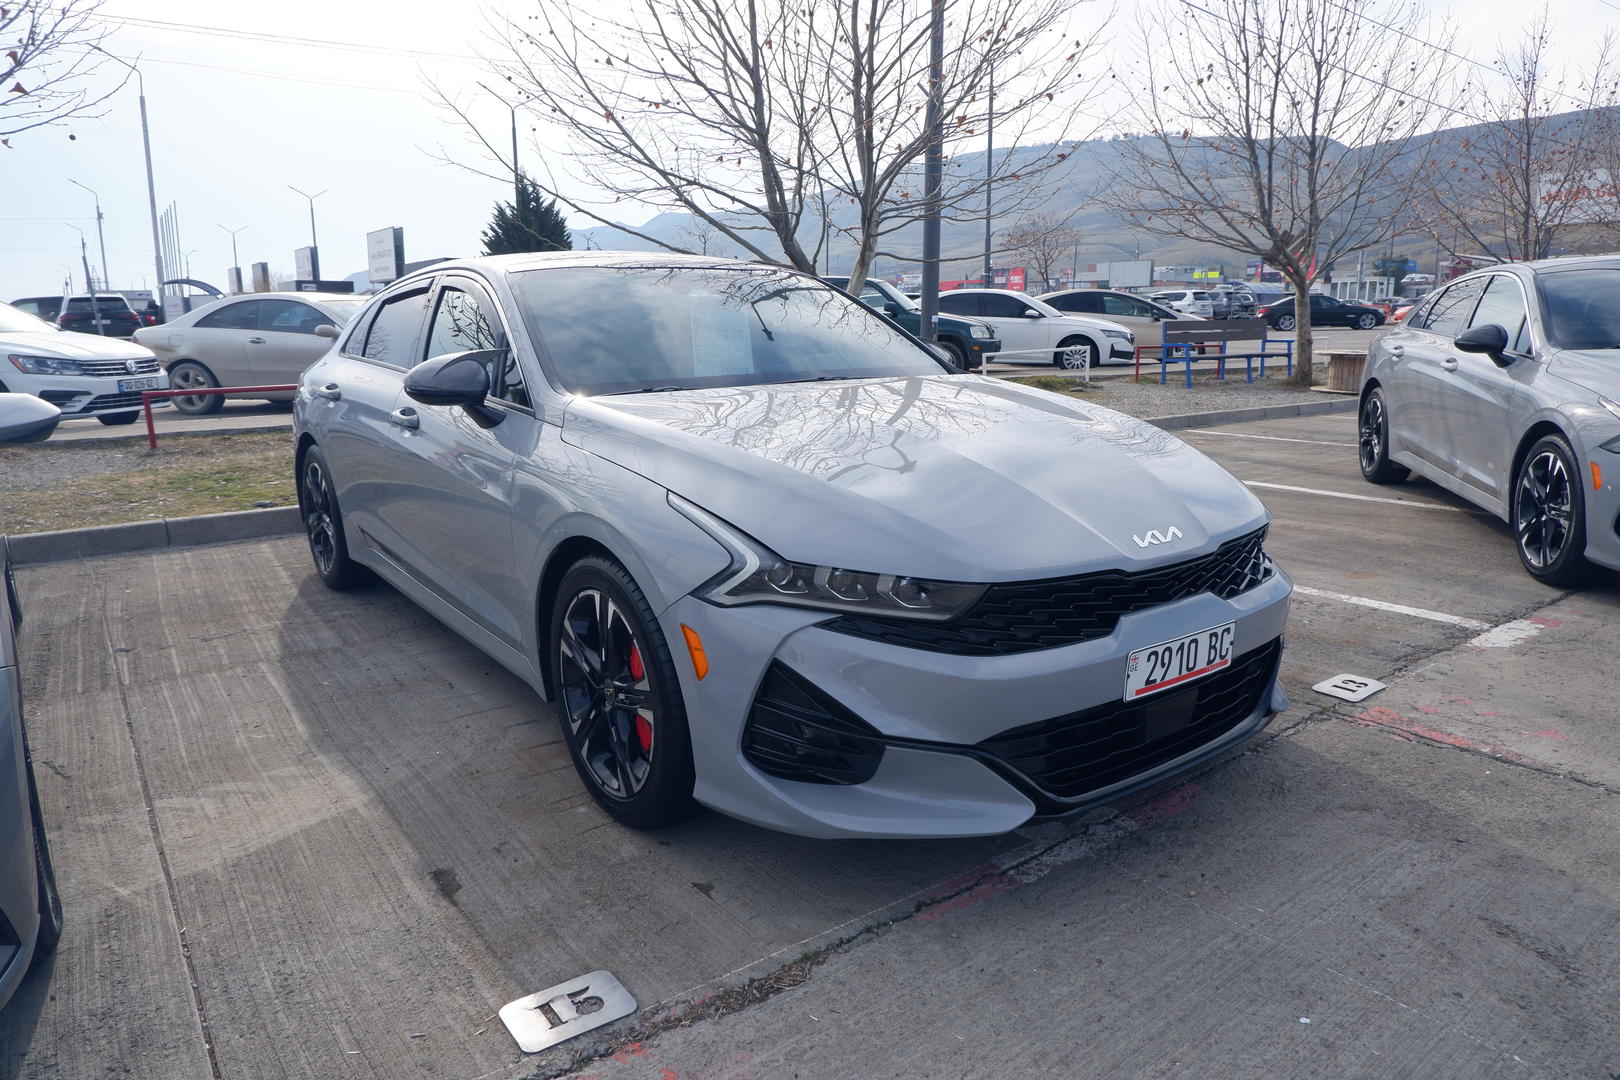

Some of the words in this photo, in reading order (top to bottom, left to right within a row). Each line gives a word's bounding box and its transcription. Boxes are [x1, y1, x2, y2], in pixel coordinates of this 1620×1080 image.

[1130, 663, 1139, 672] GE
[1144, 638, 1199, 687] 2910
[1206, 627, 1231, 666] BC
[1331, 679, 1369, 693] 13
[533, 984, 605, 1030] 15
